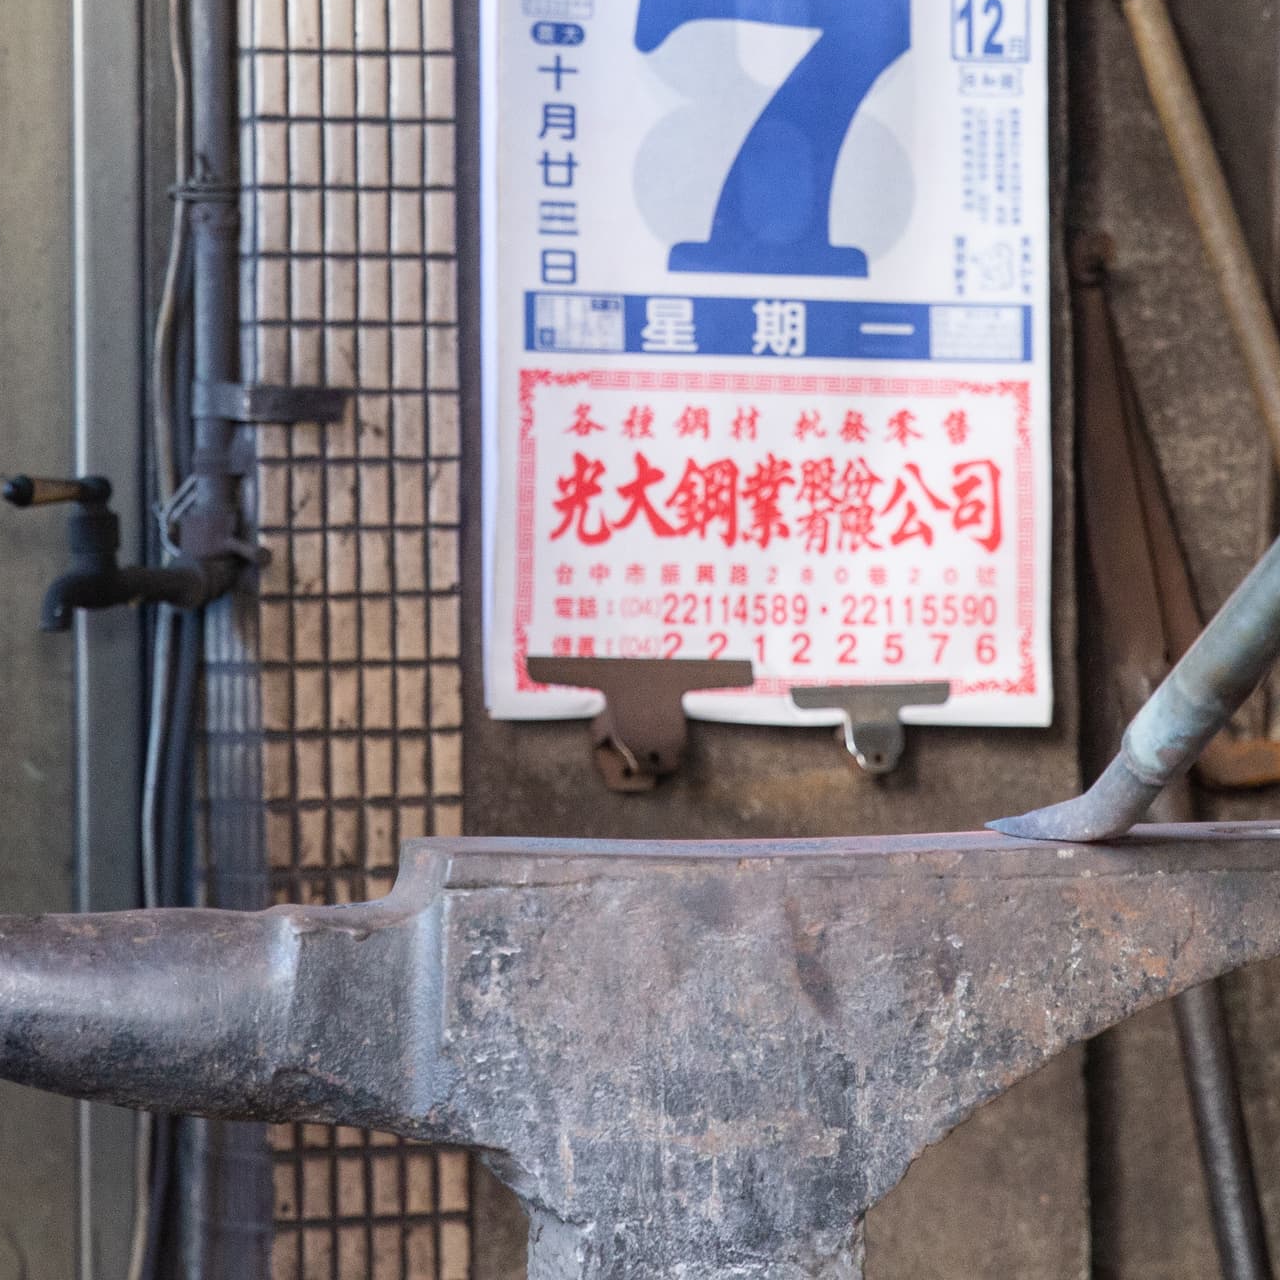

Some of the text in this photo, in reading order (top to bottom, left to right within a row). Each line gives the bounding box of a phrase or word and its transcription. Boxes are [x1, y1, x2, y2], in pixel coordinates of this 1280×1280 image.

[537, 54, 579, 286] 十月廿三日
[641, 297, 916, 358] 星期一
[548, 450, 1003, 554] 光大鋼業股份有限公司
